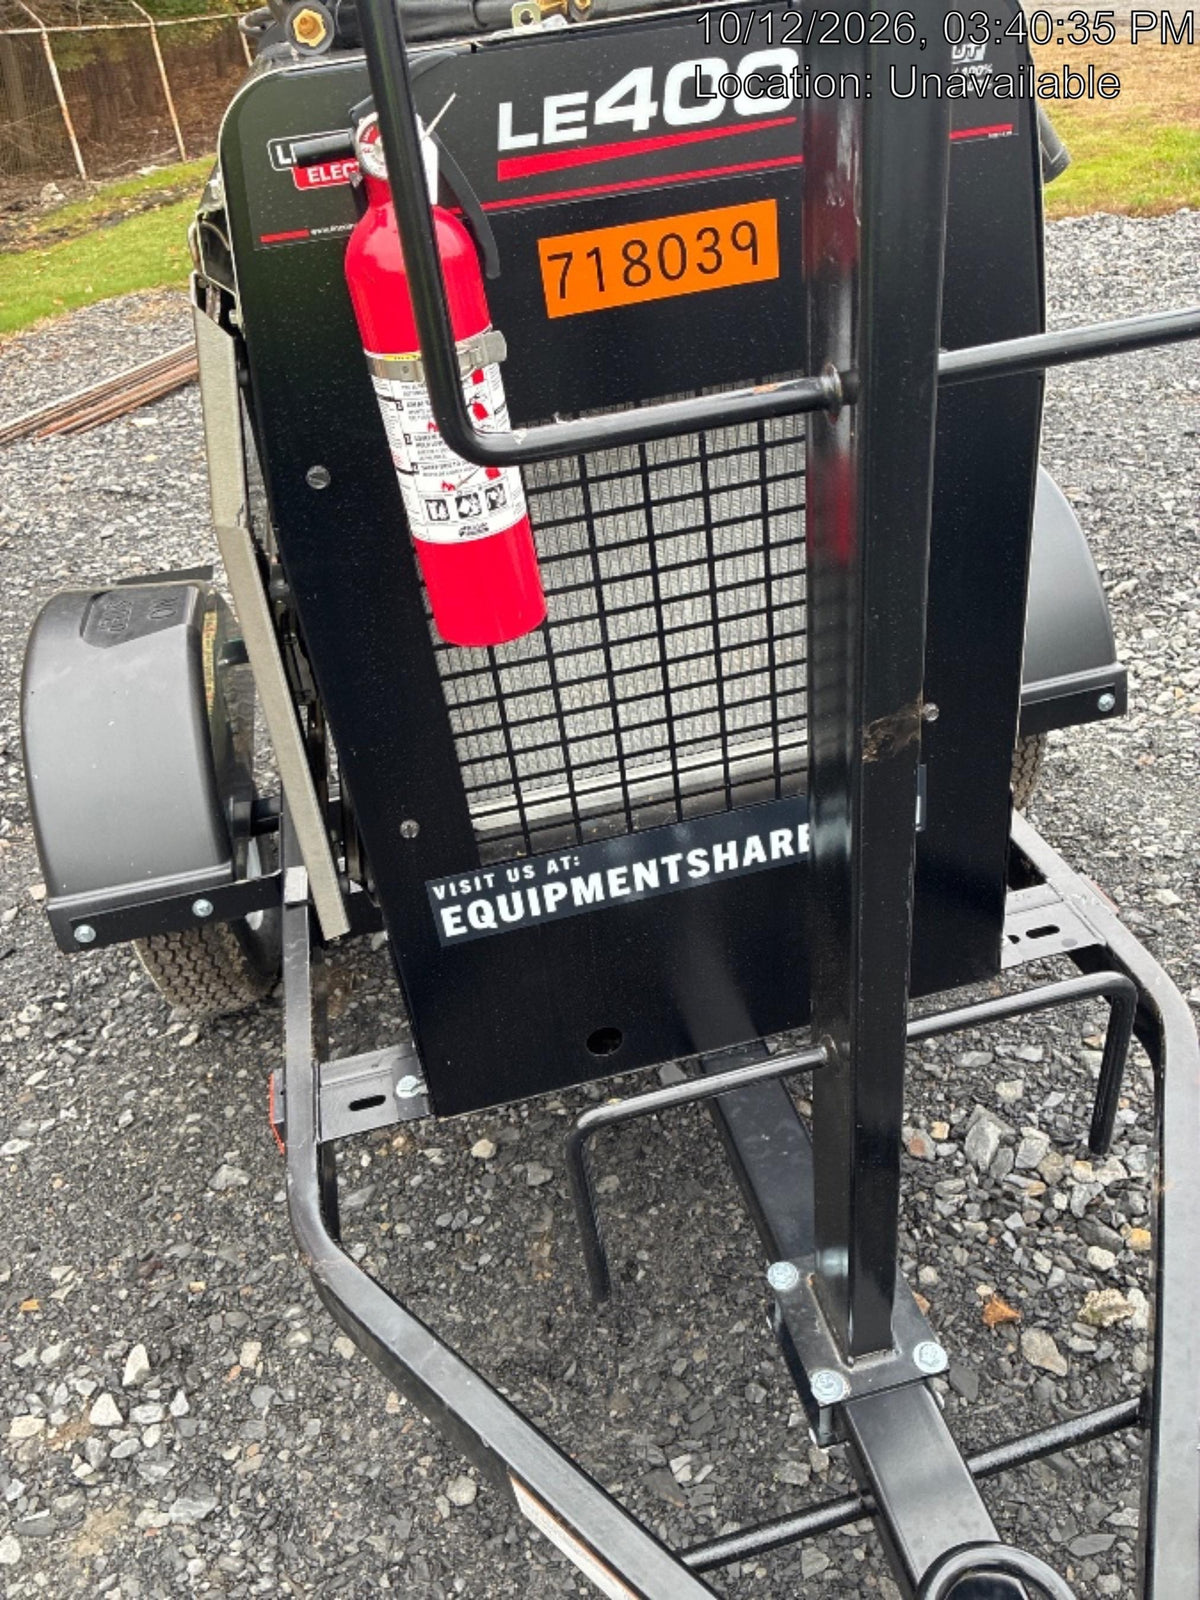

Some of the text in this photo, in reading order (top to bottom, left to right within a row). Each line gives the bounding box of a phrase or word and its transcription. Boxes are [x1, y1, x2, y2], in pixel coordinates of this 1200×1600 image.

[498, 47, 799, 151] LE400
[547, 220, 759, 300] 718039
[432, 855, 581, 900] VISIT US AT:
